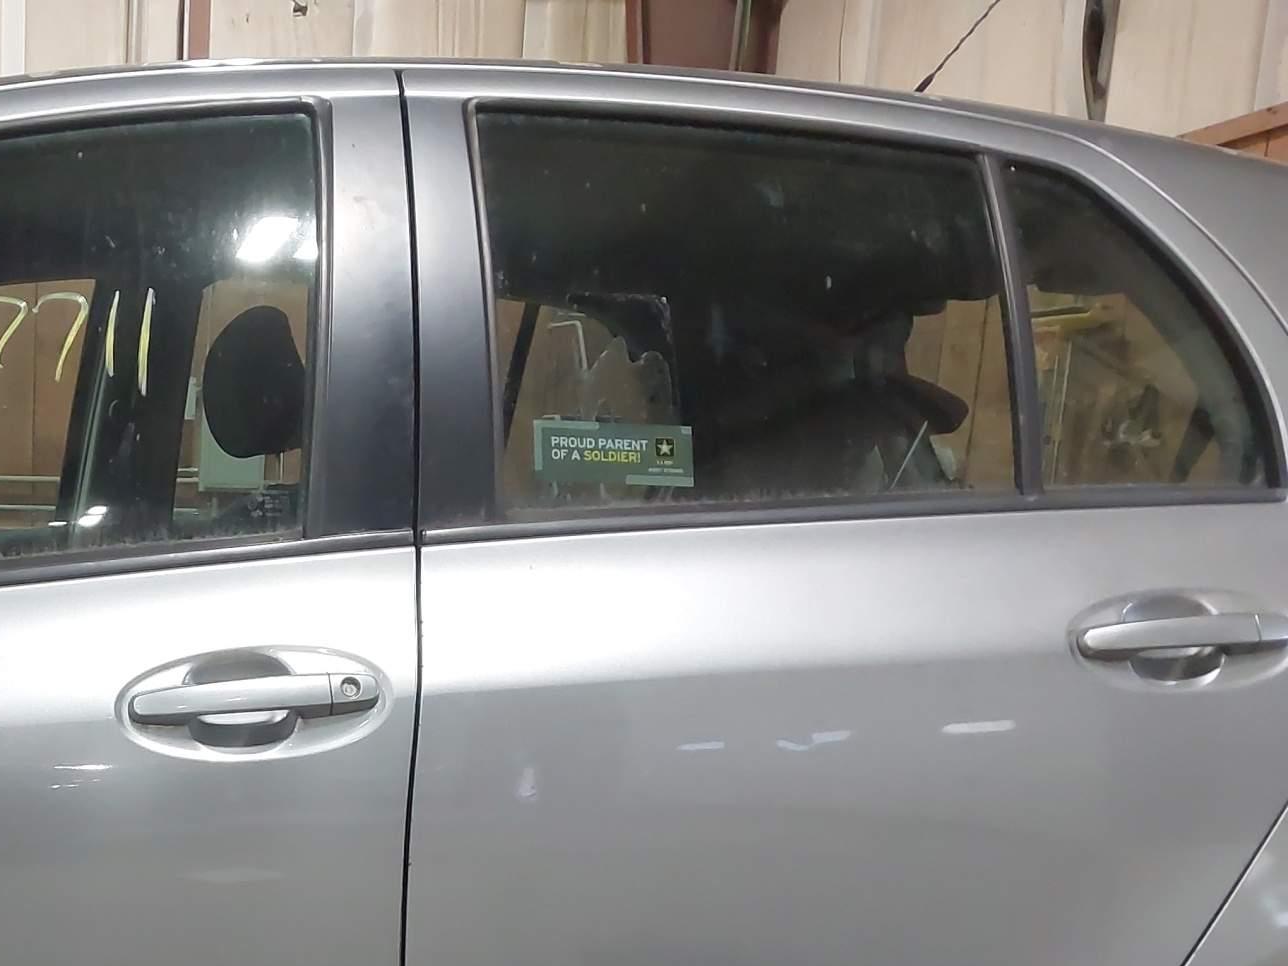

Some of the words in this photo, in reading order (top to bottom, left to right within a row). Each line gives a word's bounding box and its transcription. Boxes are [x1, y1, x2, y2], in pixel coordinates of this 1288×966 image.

[551, 436, 595, 448] PROUD
[598, 438, 648, 450] PARENT
[551, 449, 568, 460] OF
[572, 450, 580, 460] A
[583, 451, 641, 463] SOLDIER!
